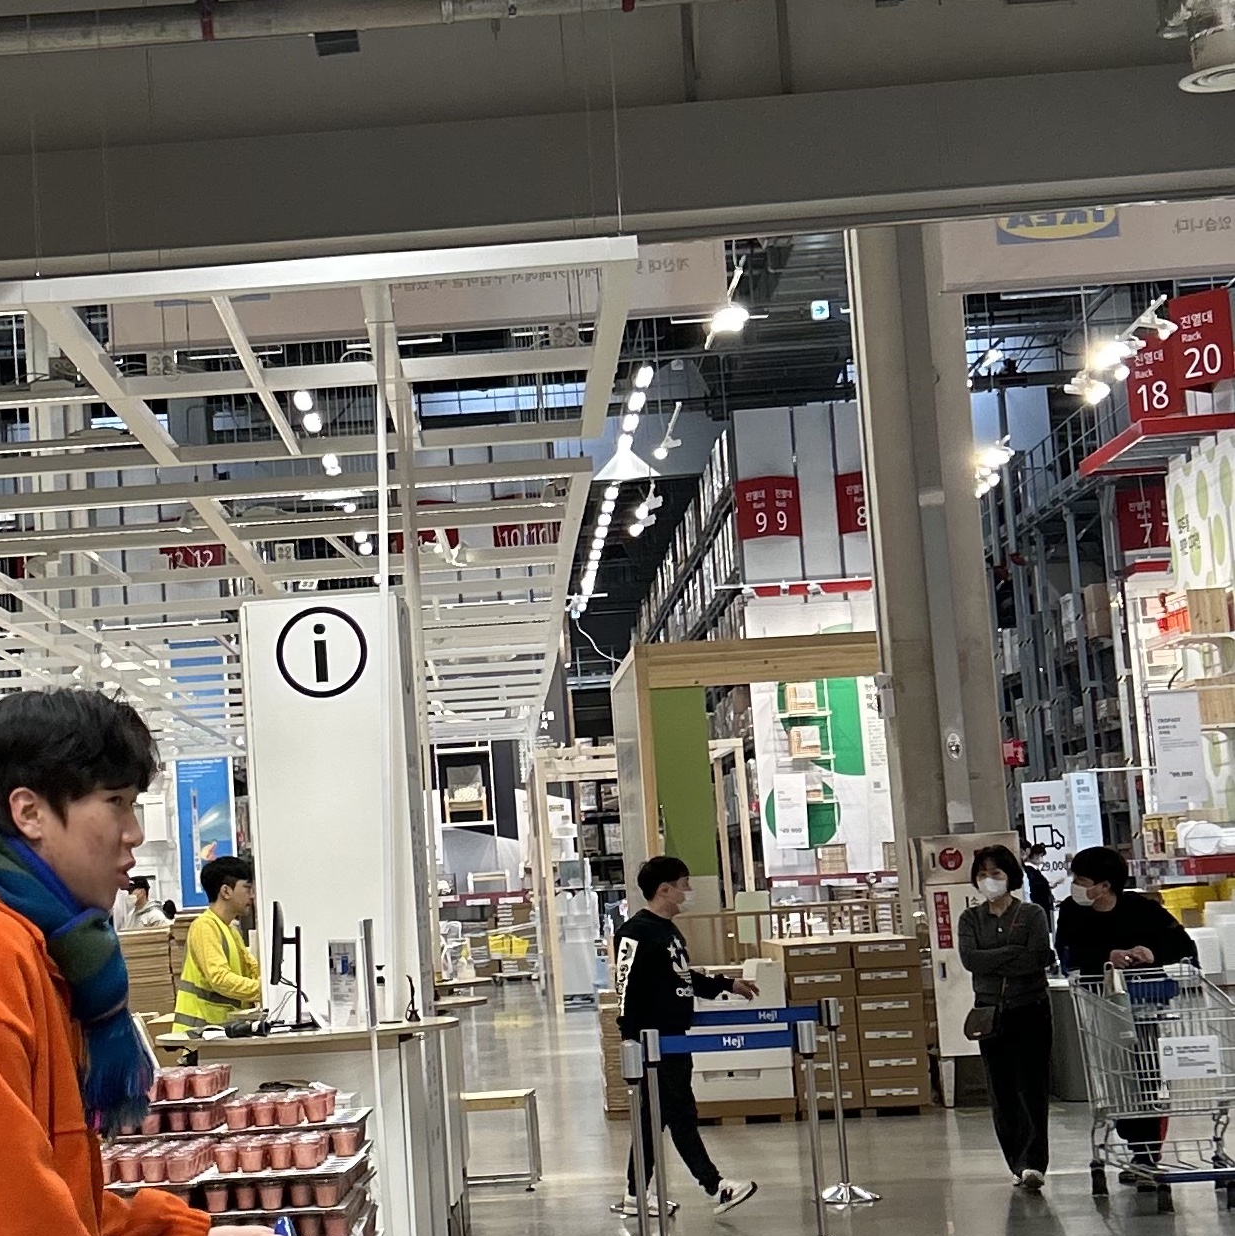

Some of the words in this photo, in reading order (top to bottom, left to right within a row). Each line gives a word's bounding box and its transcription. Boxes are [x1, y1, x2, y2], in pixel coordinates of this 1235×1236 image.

[1180, 310, 1213, 330] 진열대
[1181, 331, 1202, 343] Rack
[1134, 349, 1163, 367] 진열대
[1184, 343, 1222, 379] 20
[1135, 369, 1153, 379] Rack
[1137, 381, 1169, 412] 18
[755, 512, 768, 533] 9
[776, 510, 787, 531] 9
[856, 506, 867, 526] 8
[1140, 523, 1152, 543] 7
[758, 1010, 778, 1022] Hej!
[722, 1035, 745, 1048] Hej!
